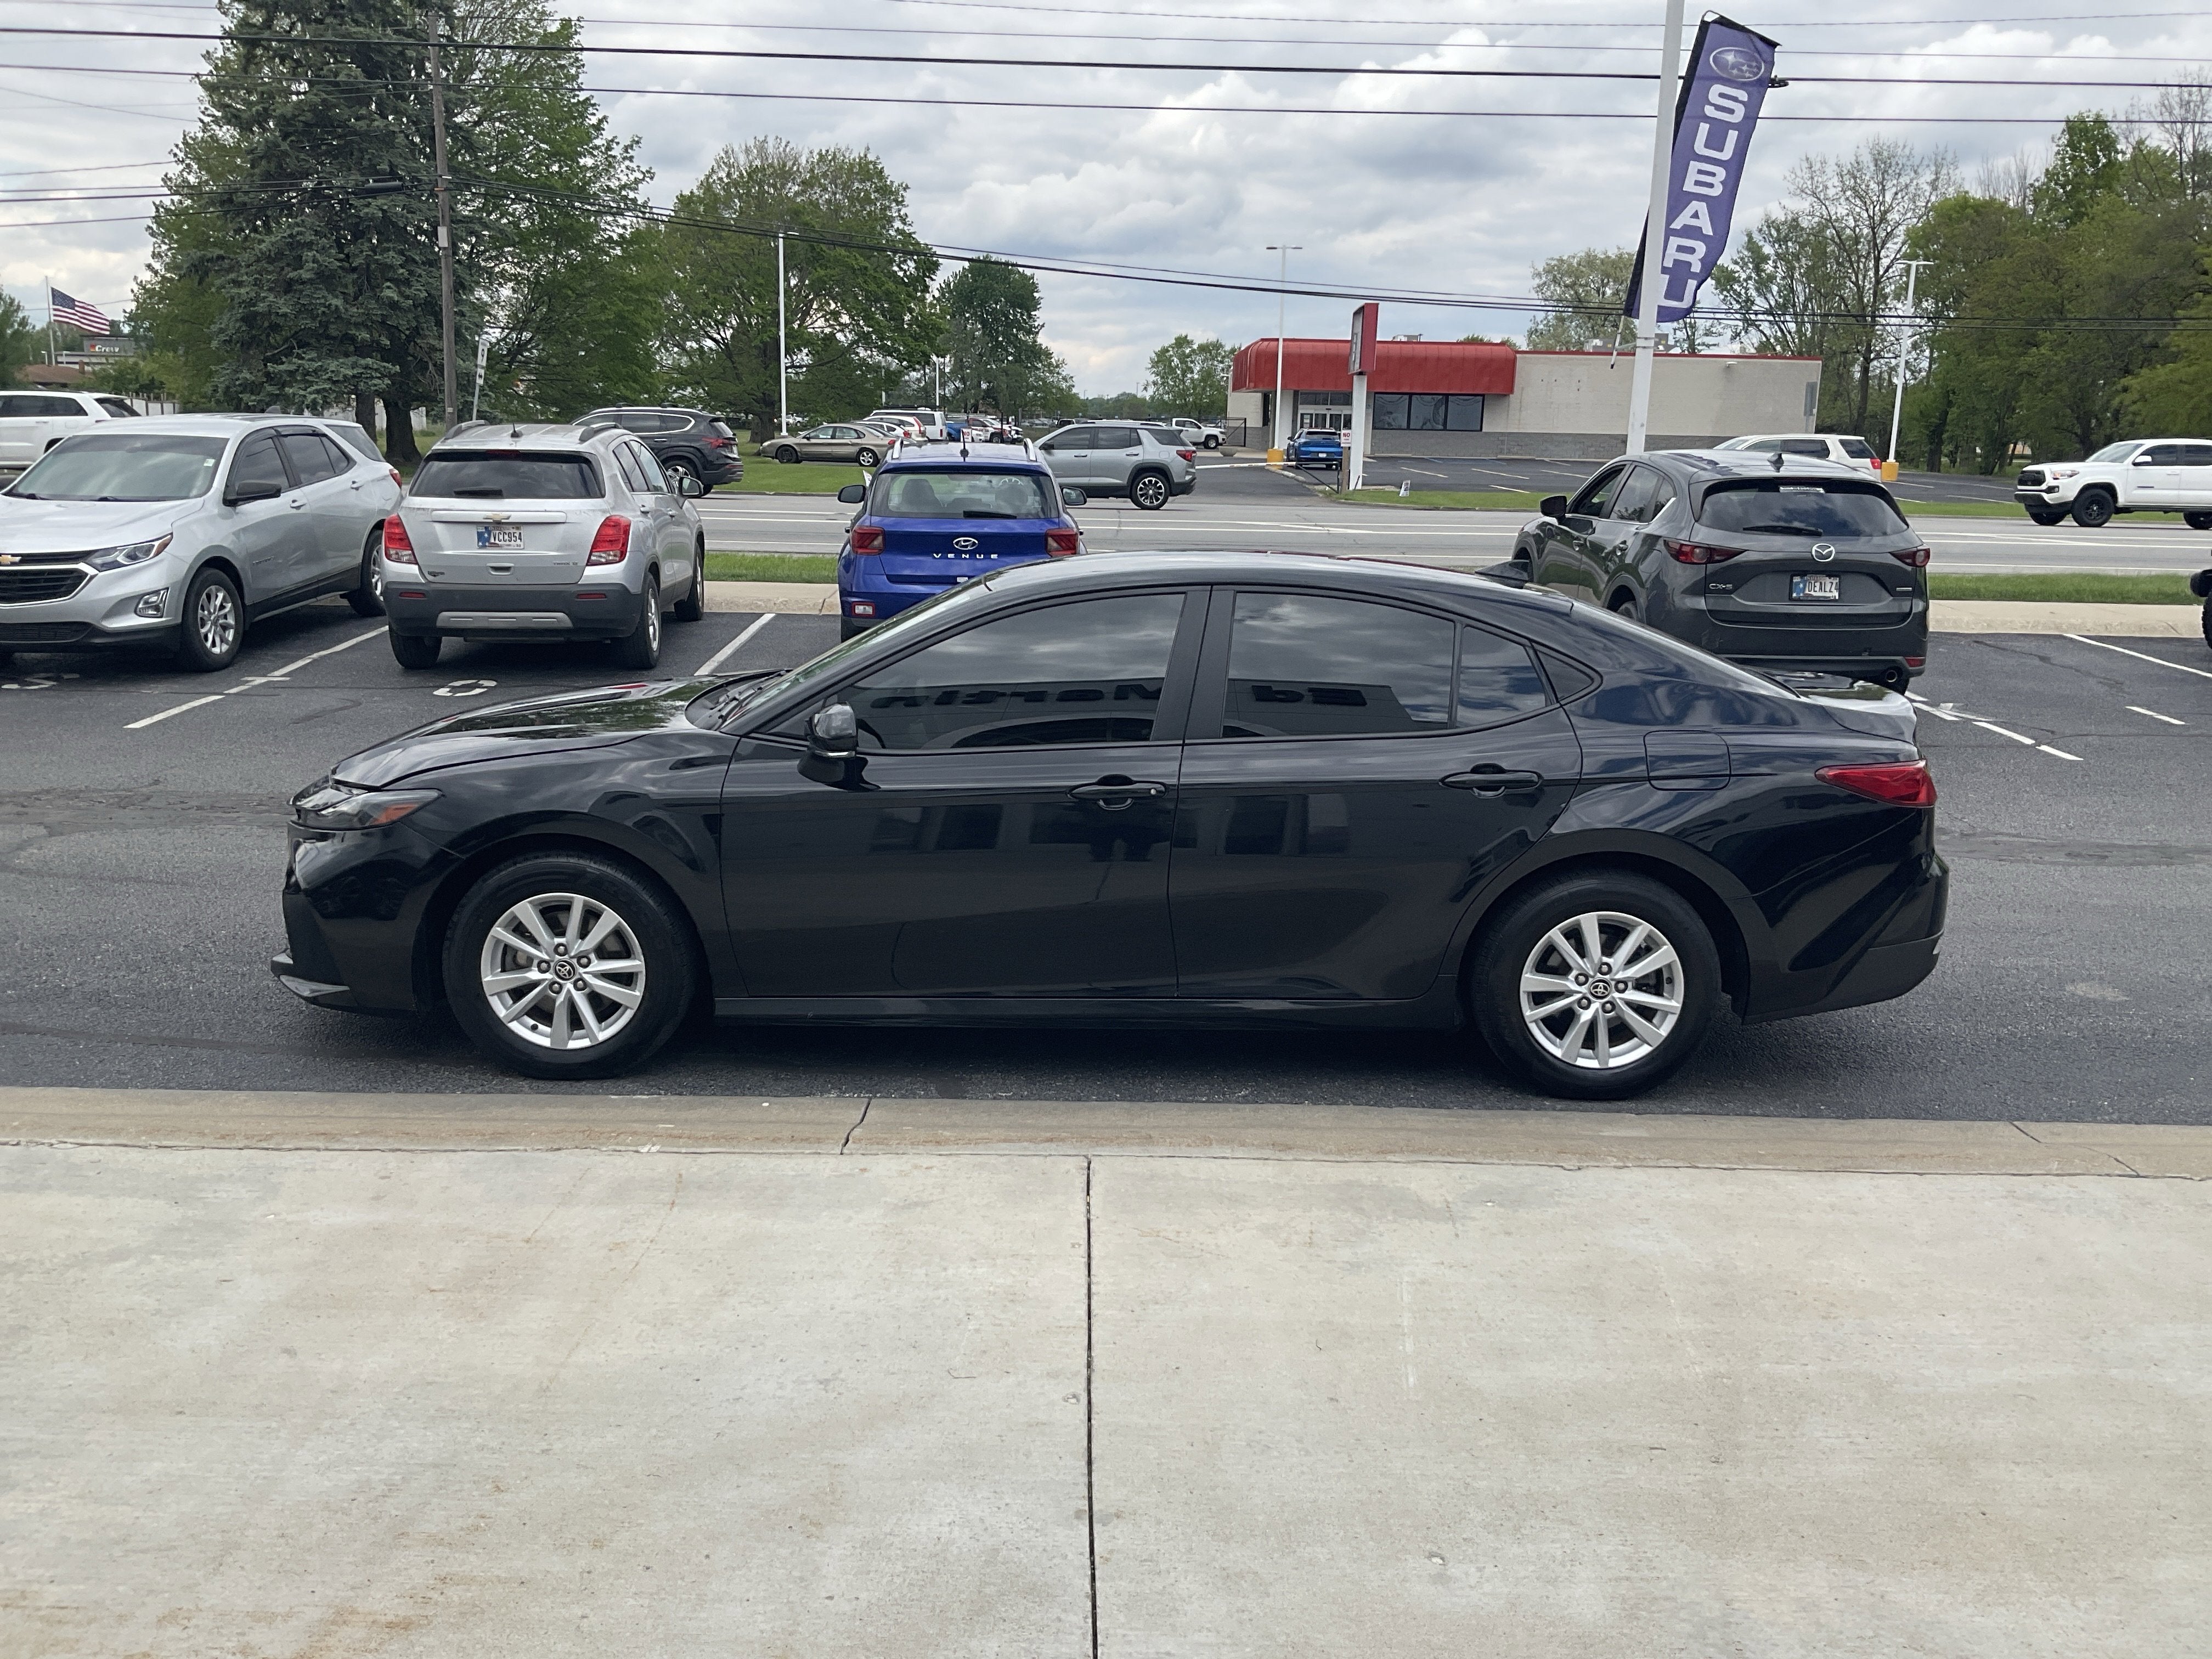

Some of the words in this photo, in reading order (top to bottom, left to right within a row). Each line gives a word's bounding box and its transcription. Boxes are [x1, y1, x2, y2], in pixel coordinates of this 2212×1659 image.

[1657, 84, 1748, 308] SUBARU
[492, 532, 522, 543] VCC954
[1808, 582, 1838, 593] DEALZ4
